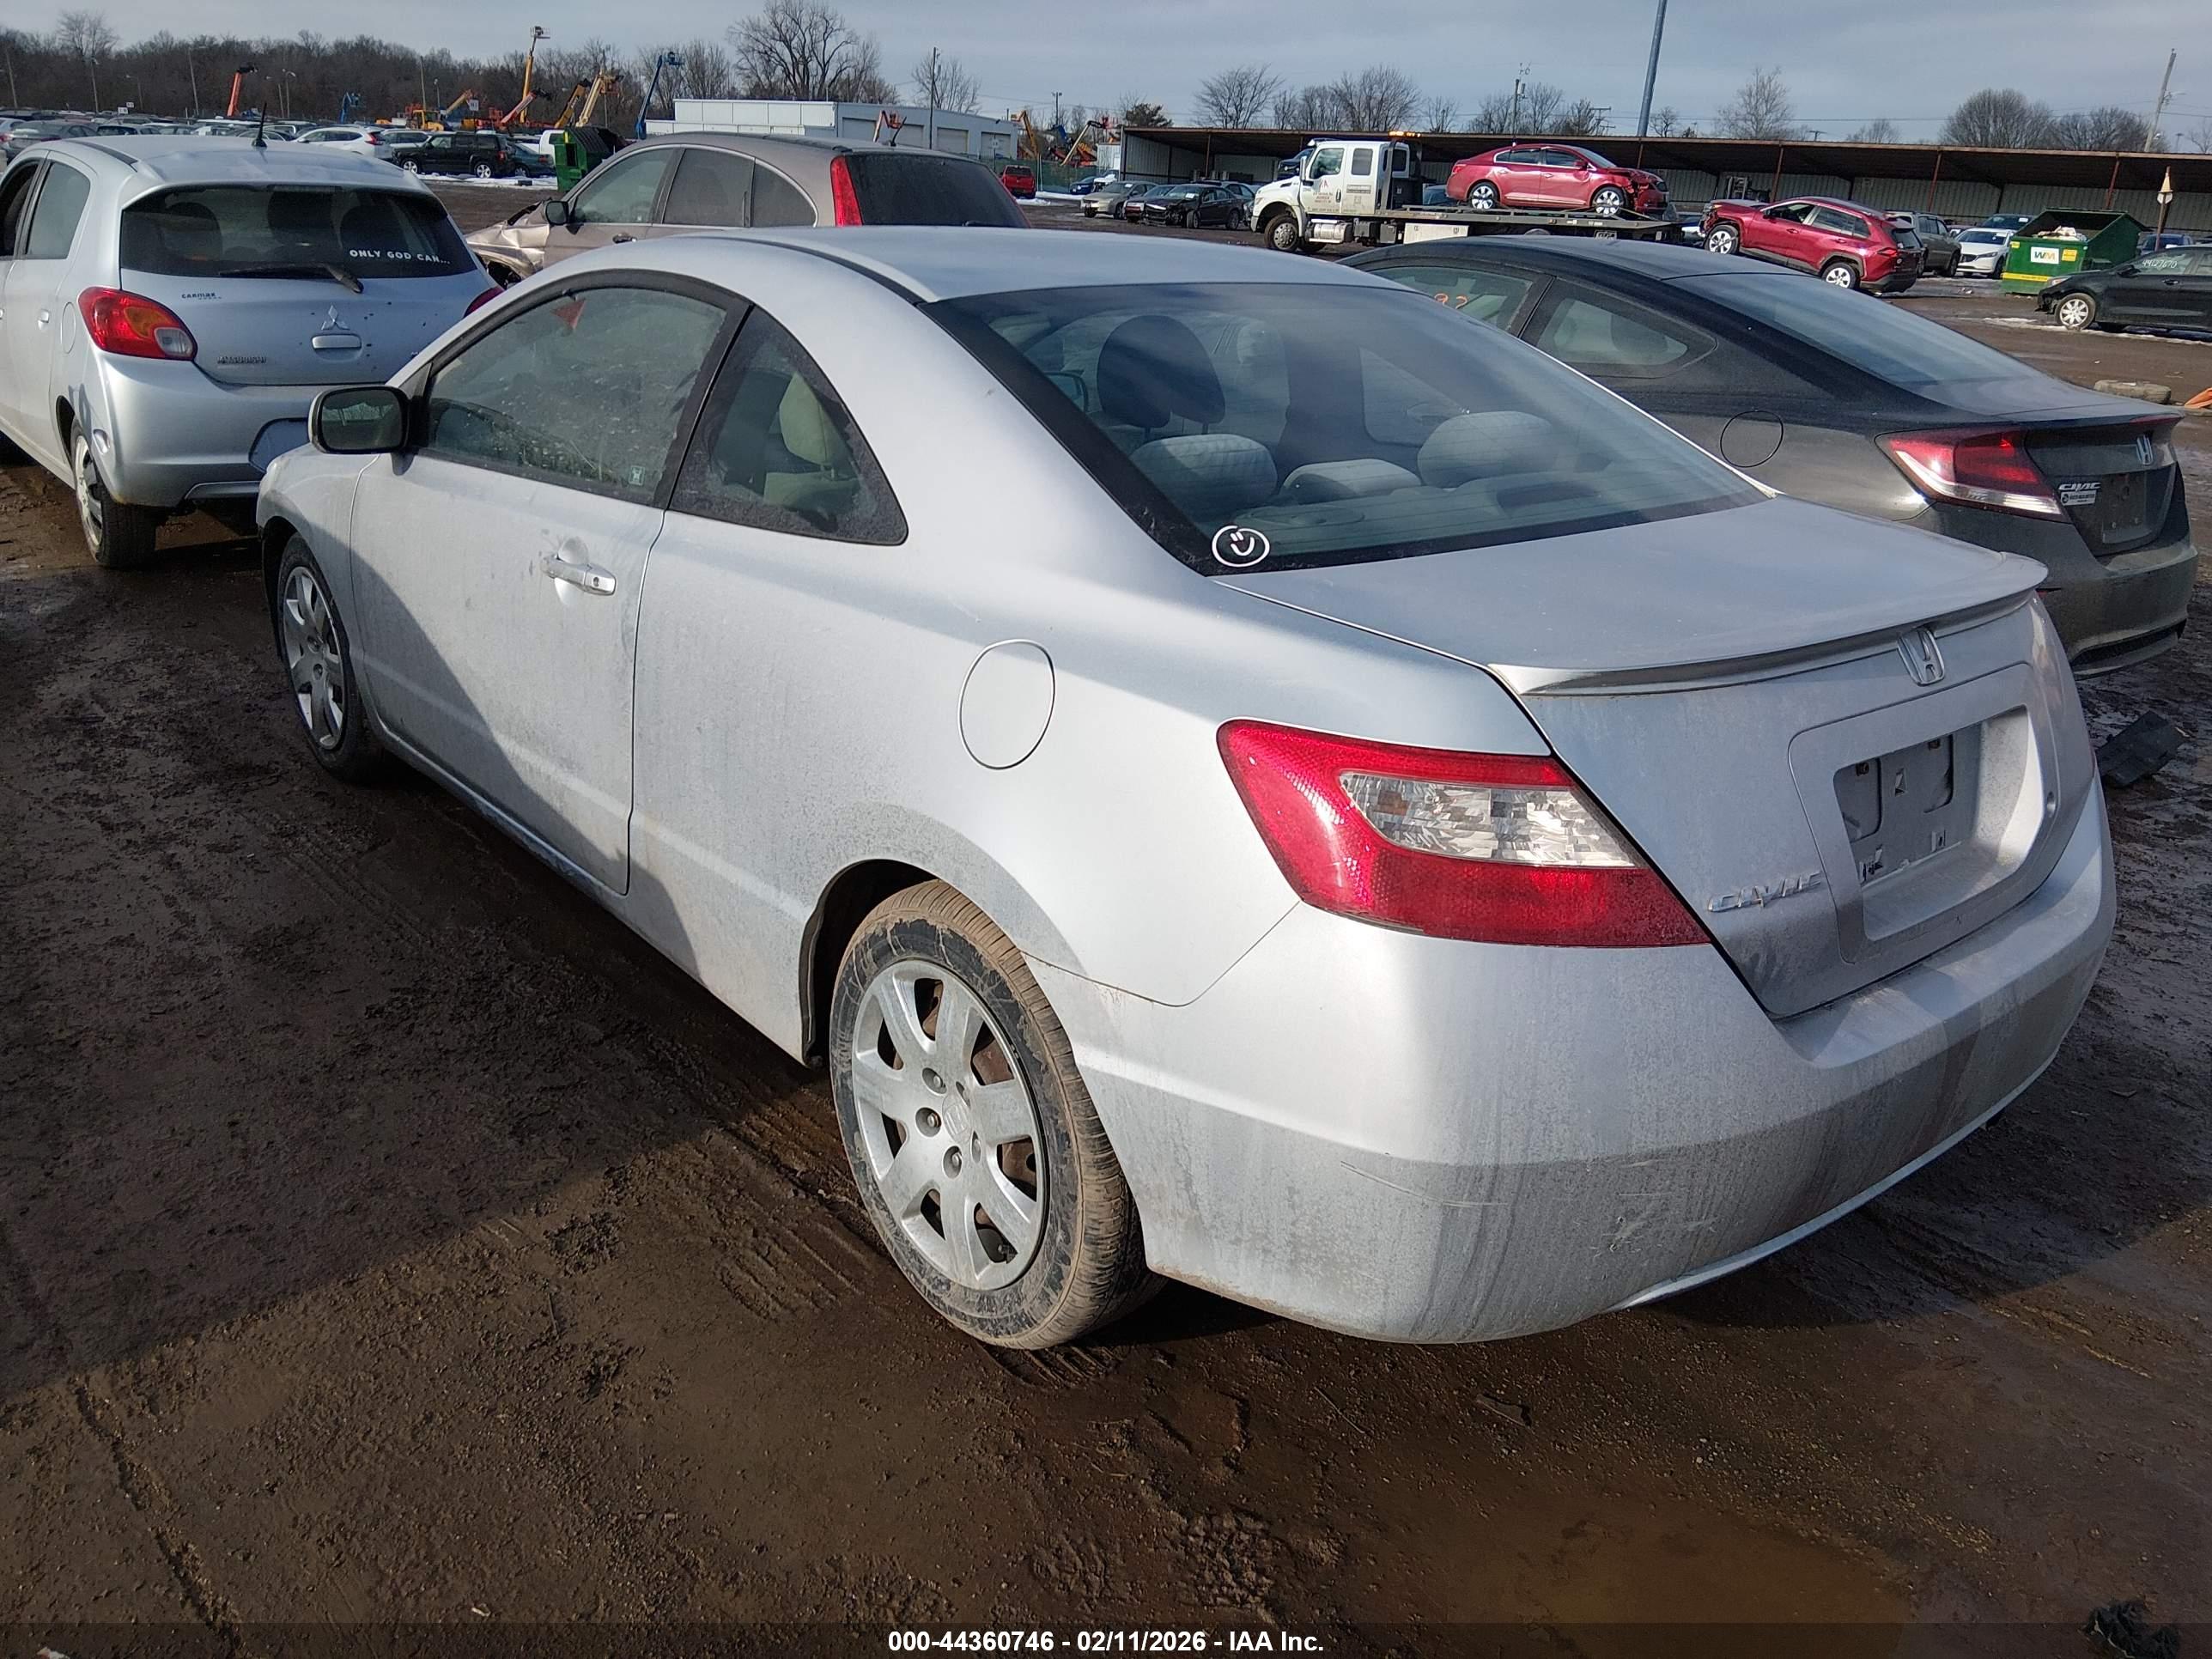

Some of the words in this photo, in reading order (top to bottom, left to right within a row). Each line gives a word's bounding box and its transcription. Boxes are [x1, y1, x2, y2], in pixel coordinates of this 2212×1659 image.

[349, 249, 381, 258] ONLY
[386, 251, 412, 260] GOD
[2033, 251, 2056, 260] WM
[2057, 481, 2102, 493] CIVIC
[1706, 869, 1824, 913] CIVIC
